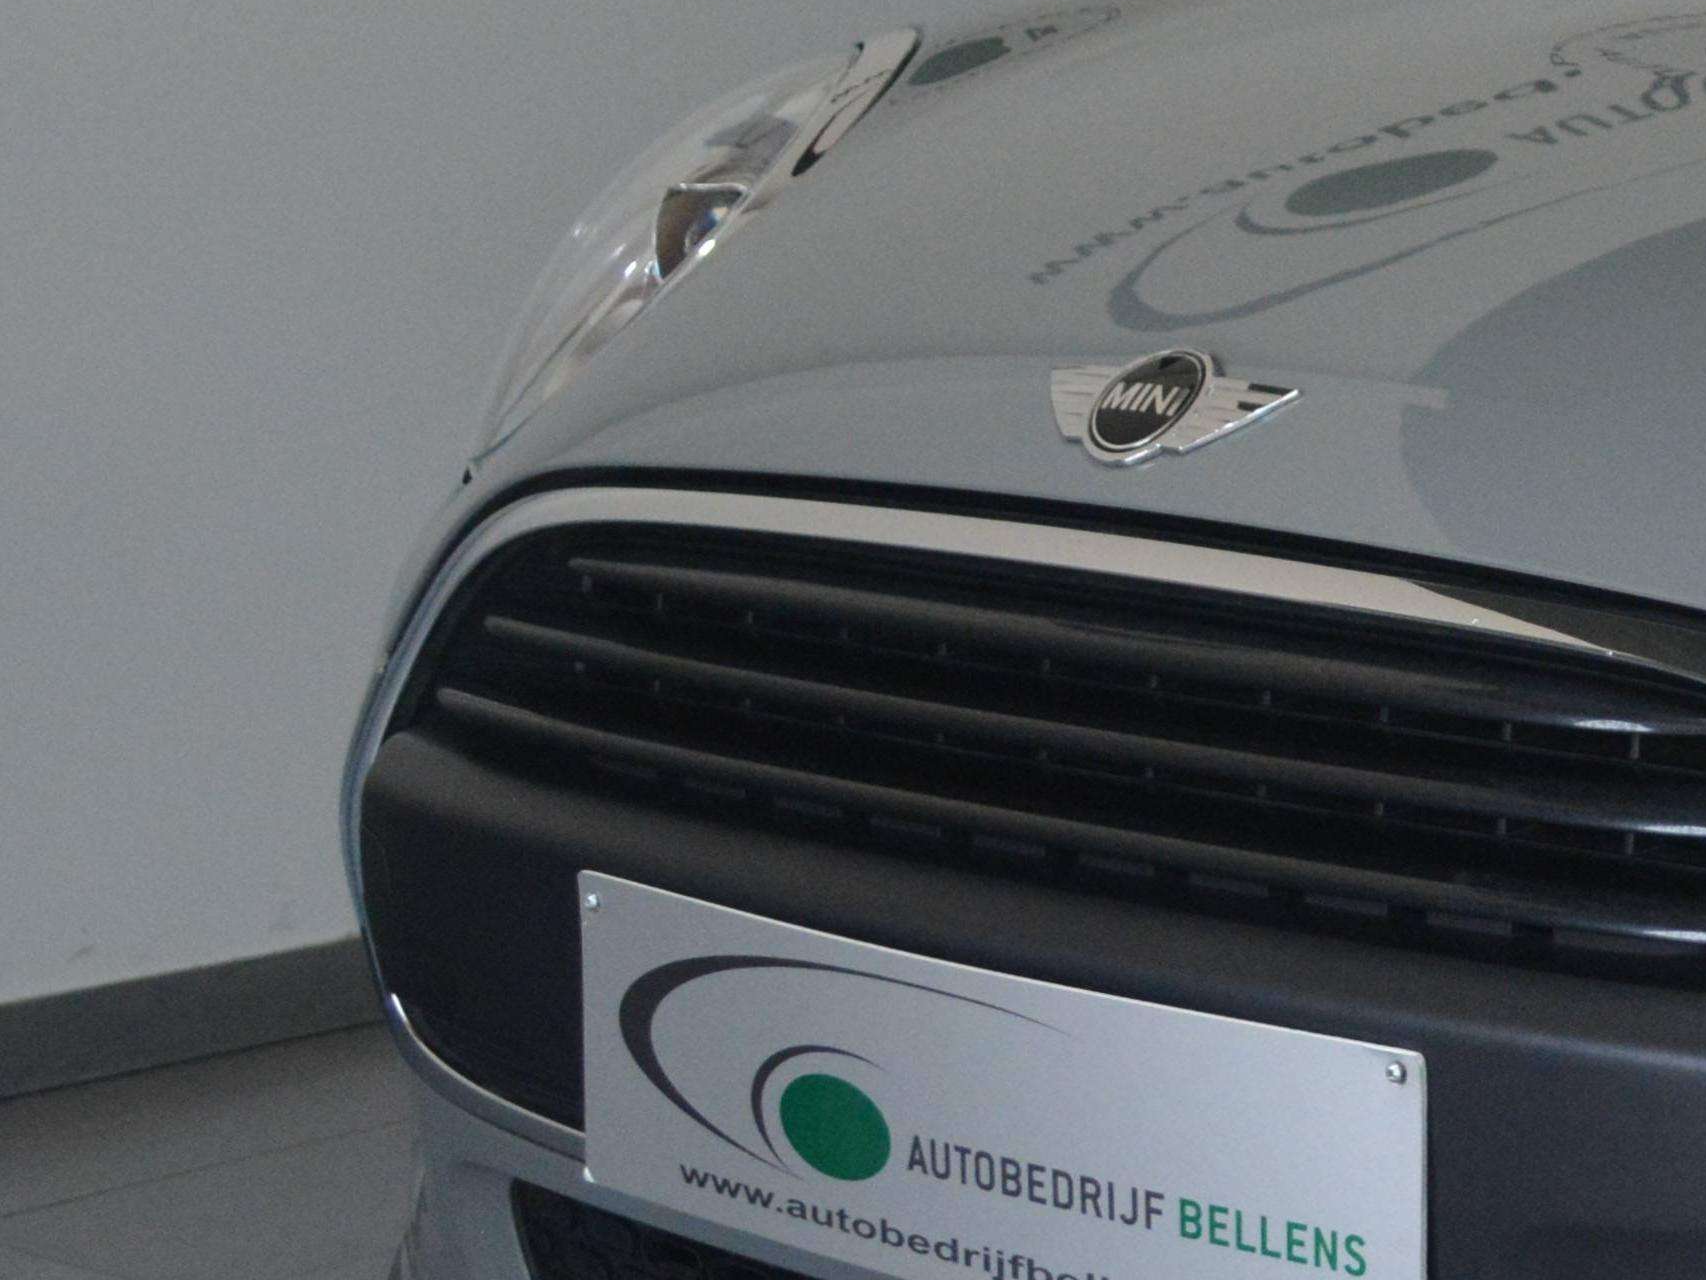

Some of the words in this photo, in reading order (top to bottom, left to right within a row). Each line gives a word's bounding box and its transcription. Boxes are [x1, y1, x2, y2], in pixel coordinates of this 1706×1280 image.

[1100, 380, 1191, 418] MINI
[906, 1134, 1166, 1230] AUTOBEDRIJF
[1178, 1197, 1368, 1277] BELLENS
